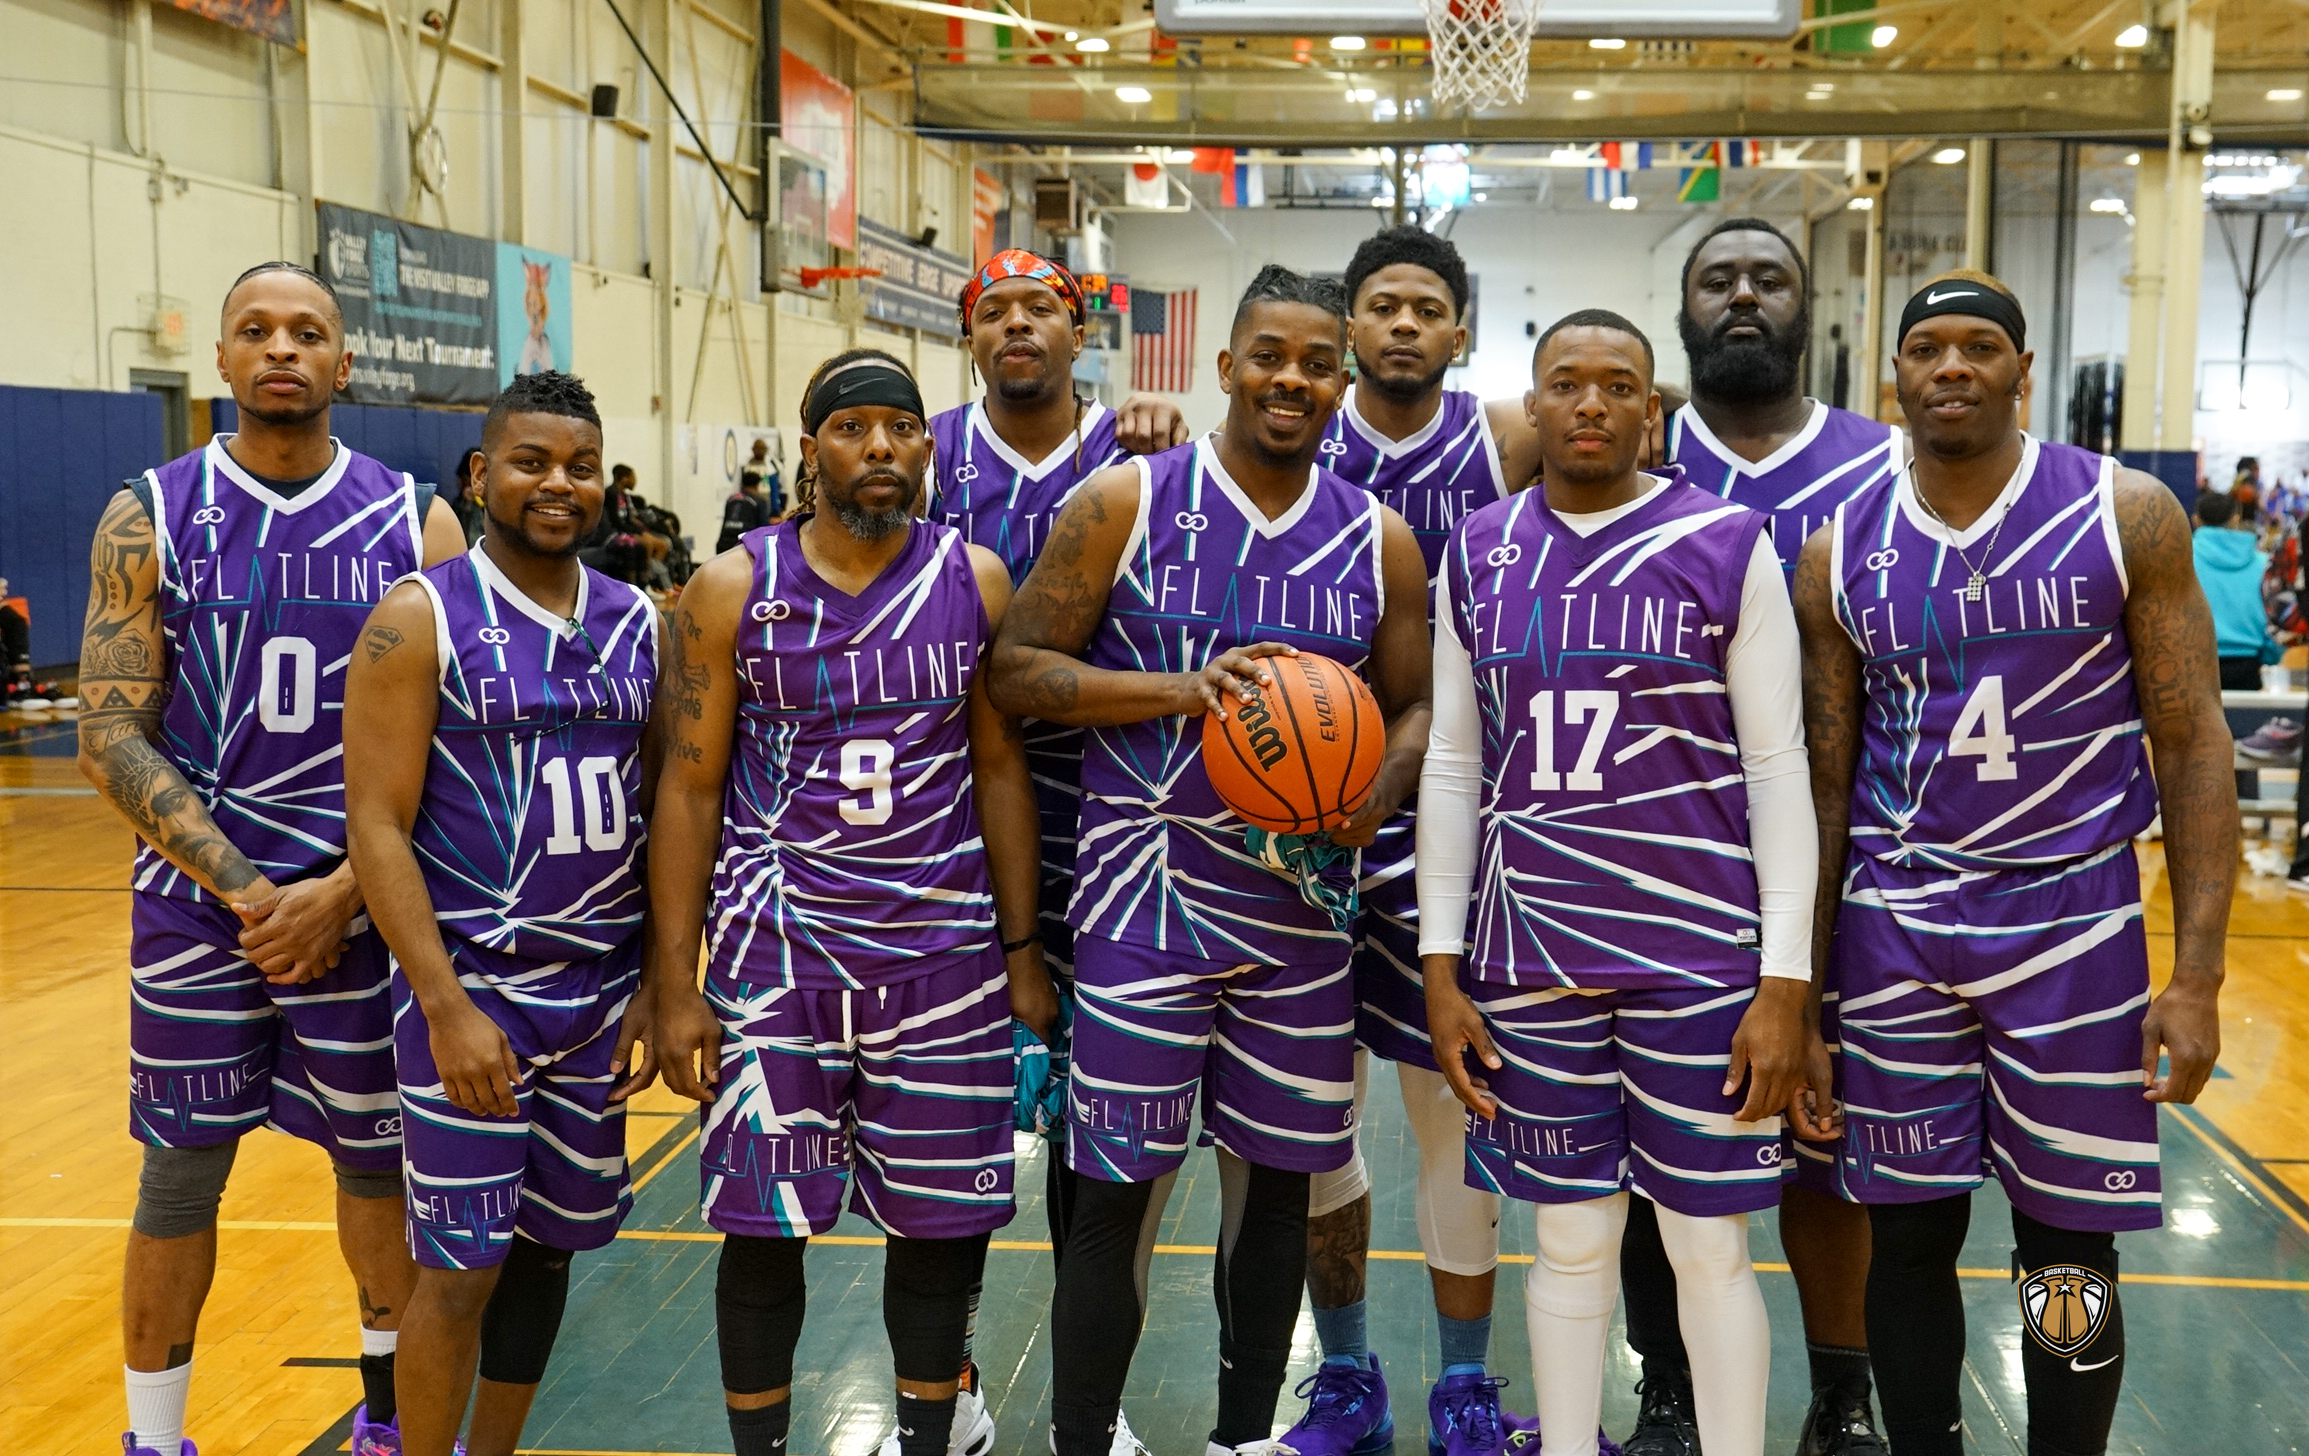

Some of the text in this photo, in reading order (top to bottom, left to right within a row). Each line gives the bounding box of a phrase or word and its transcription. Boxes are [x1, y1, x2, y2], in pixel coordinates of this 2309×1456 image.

[344, 327, 369, 357] ook
[395, 333, 424, 363] Next
[1381, 488, 1475, 531] TLINE
[1160, 565, 1363, 642] FLATLINE
[1473, 593, 1697, 659] FLATLINE
[1862, 576, 2091, 658] FLATLINE
[259, 636, 317, 734] 0
[746, 641, 970, 711] FLATLINE
[1296, 655, 1336, 743] EVOLUTIO
[1237, 674, 1288, 774] Wilo
[1529, 689, 1620, 791] 17
[1948, 674, 2018, 782] 4
[541, 756, 627, 856] 10
[838, 739, 895, 826] 9
